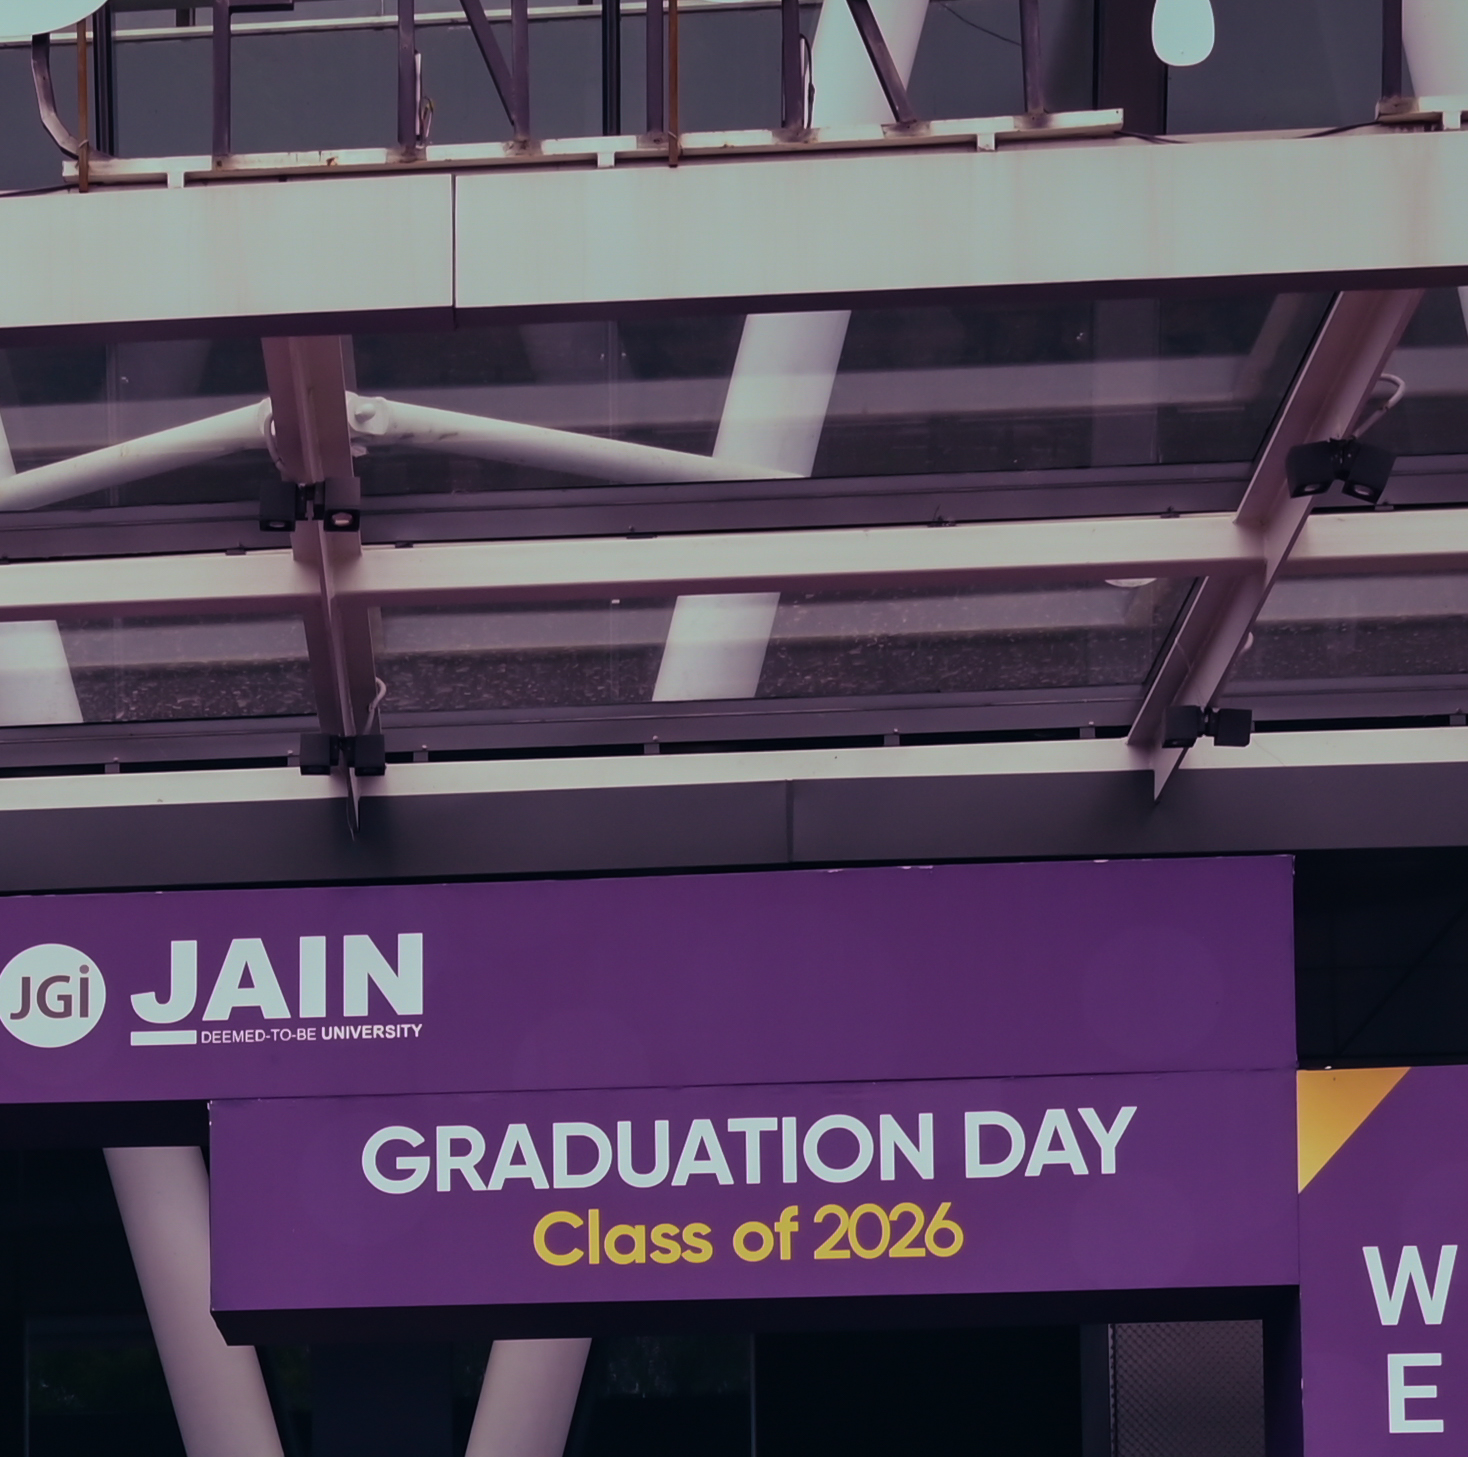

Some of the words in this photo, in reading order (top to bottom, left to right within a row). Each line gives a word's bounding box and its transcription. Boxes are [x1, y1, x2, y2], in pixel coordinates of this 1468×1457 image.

[130, 932, 424, 1024] JAIN
[201, 1028, 317, 1045] DEEMED-TO-BE
[321, 1023, 423, 1041] UNIVERSITY
[361, 1113, 936, 1195] GRADUATION
[963, 1106, 1138, 1179] DAY
[533, 1210, 714, 1267] Class
[732, 1205, 799, 1264] of
[812, 1201, 965, 1261] 2026
